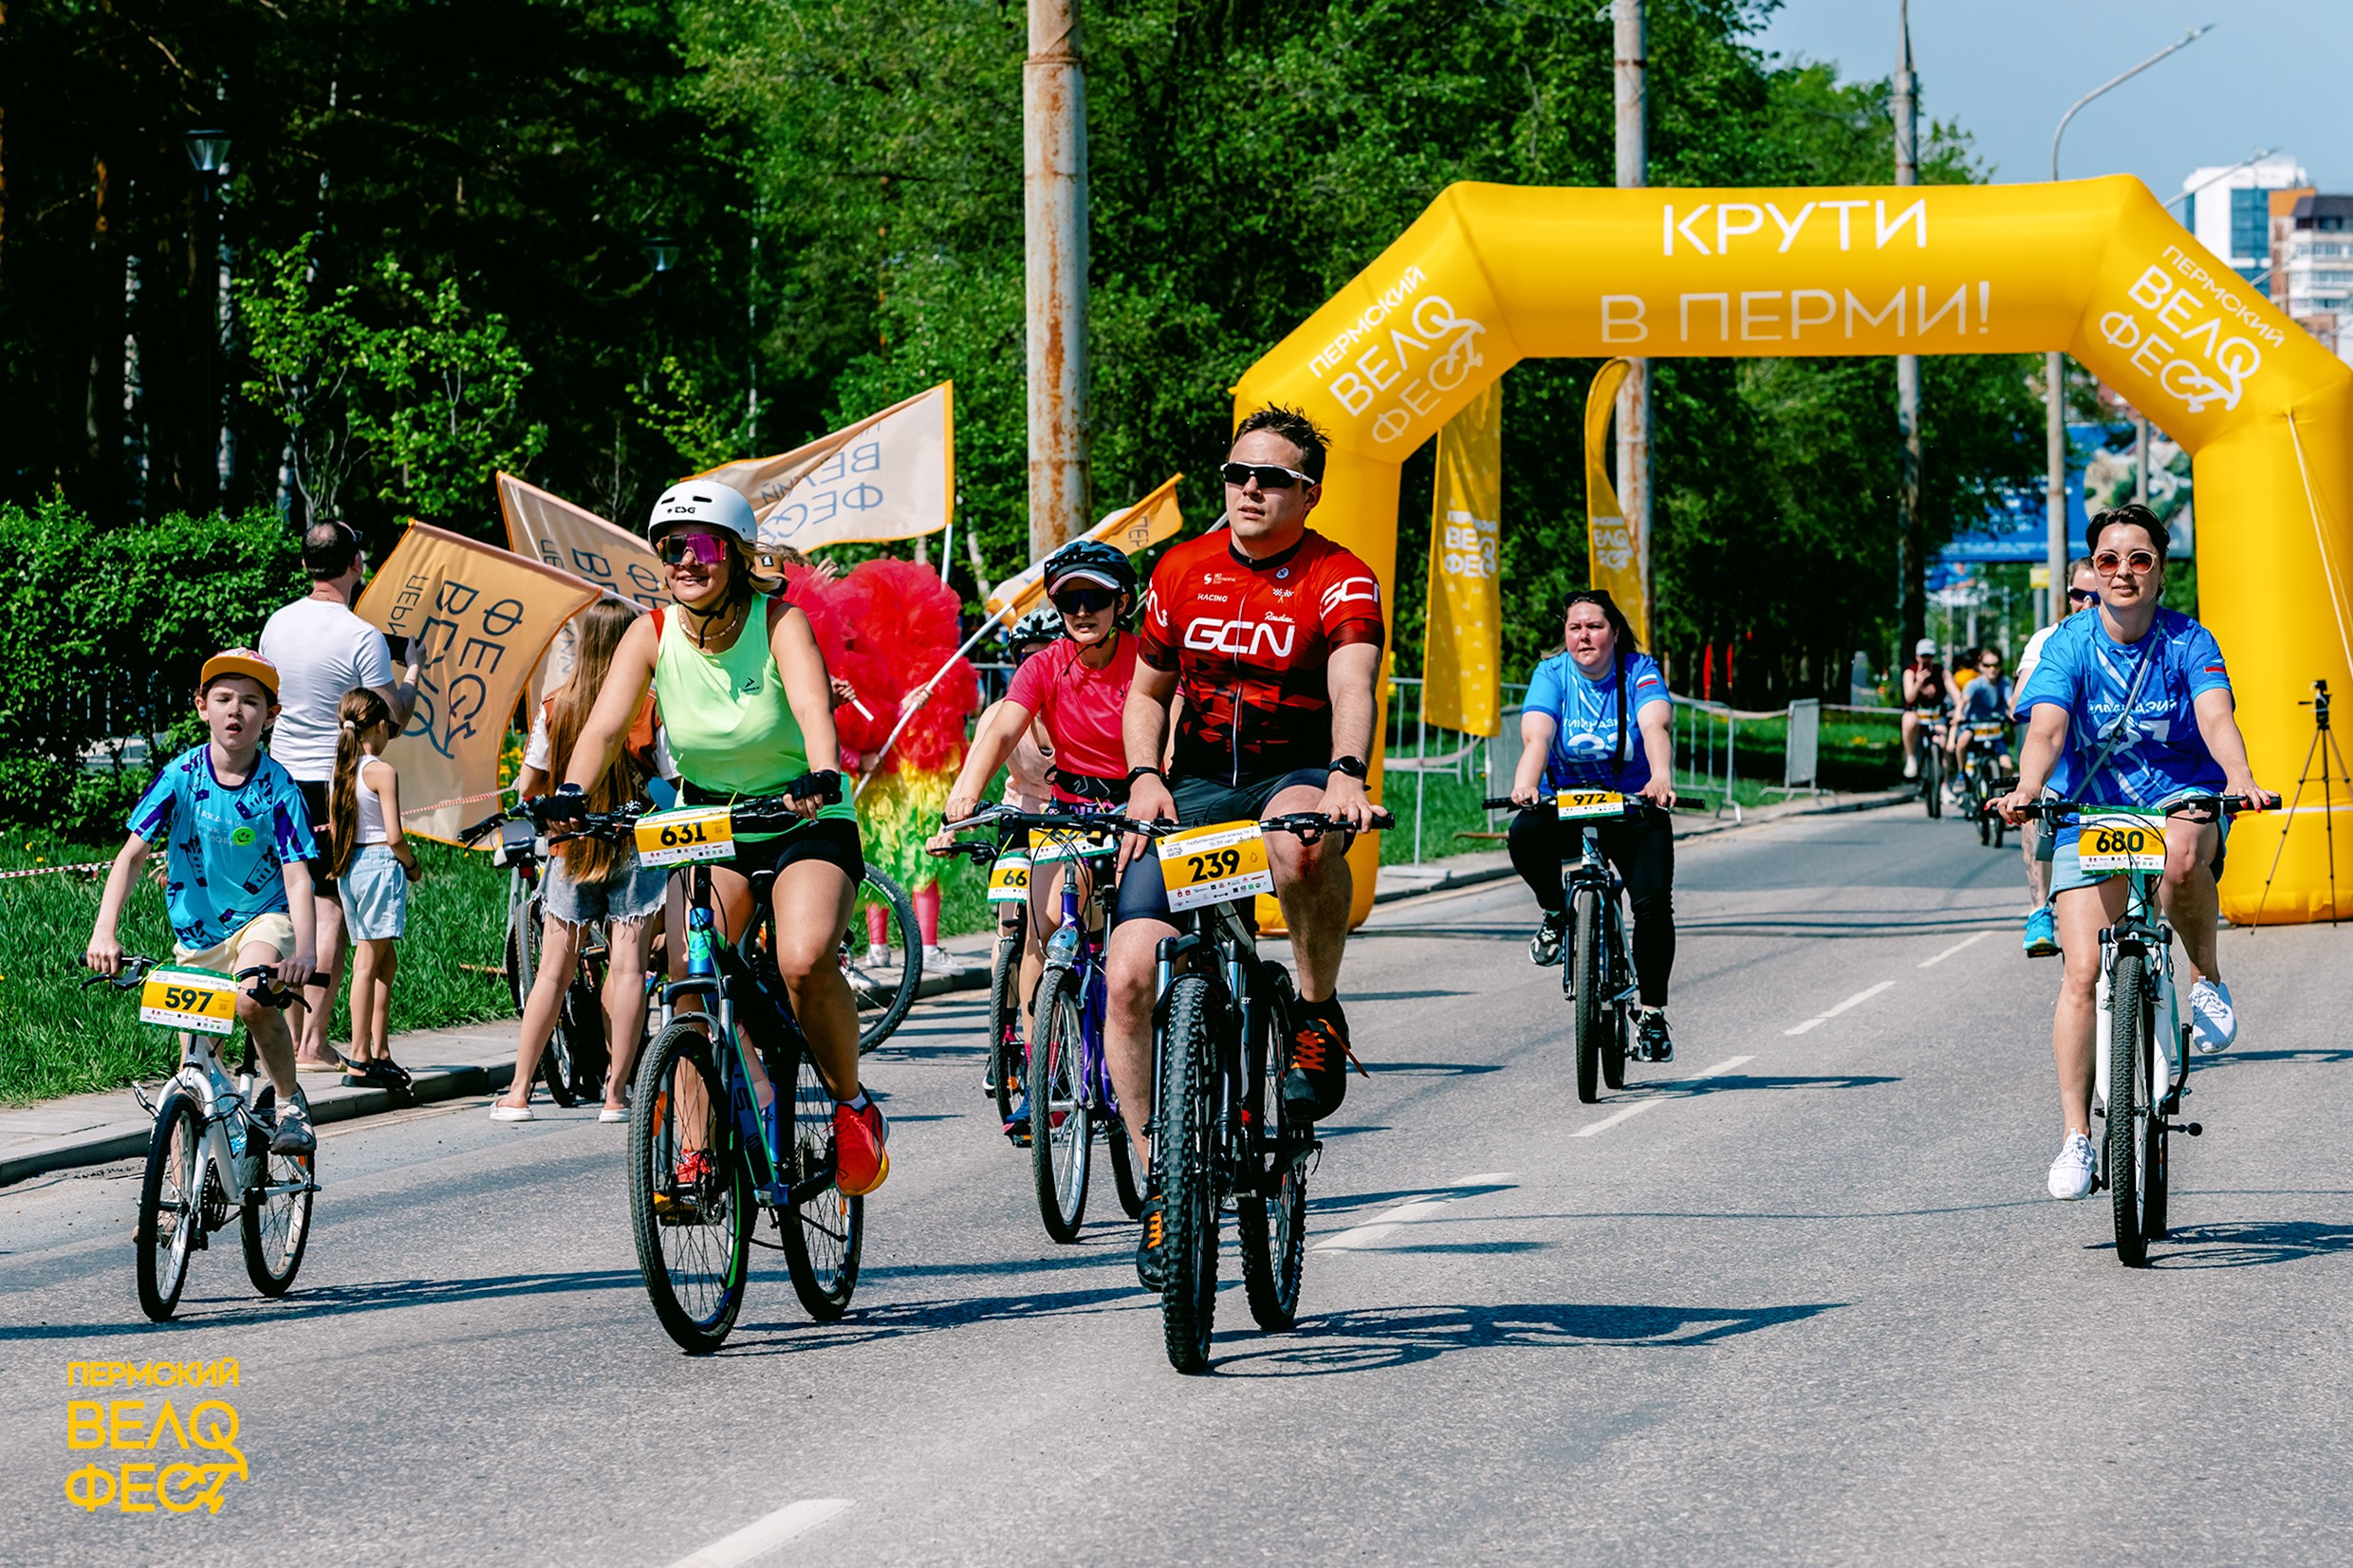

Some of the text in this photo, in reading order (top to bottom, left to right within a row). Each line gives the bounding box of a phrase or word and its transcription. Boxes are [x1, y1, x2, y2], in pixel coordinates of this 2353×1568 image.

[1662, 198, 1926, 256] КРУТИ
[1601, 281, 1991, 342] В ПЕРМИ!
[2161, 244, 2285, 348] ПЕРМСКИЙ
[1307, 265, 1427, 378] ПЕРМСКИЙ
[2127, 264, 2261, 406] ВЕЛО
[1328, 295, 1484, 417] ВЕЛО
[2100, 310, 2235, 414] ФЕСТ
[1372, 329, 1483, 443] ФЕСТ
[1197, 593, 1228, 603] RACING
[1183, 617, 1296, 657] GCN
[1572, 793, 1607, 806] 972
[660, 821, 707, 846] 631
[2096, 831, 2144, 853] 680
[1003, 870, 1027, 886] 66
[1188, 849, 1240, 883] 239
[165, 987, 214, 1012] 597
